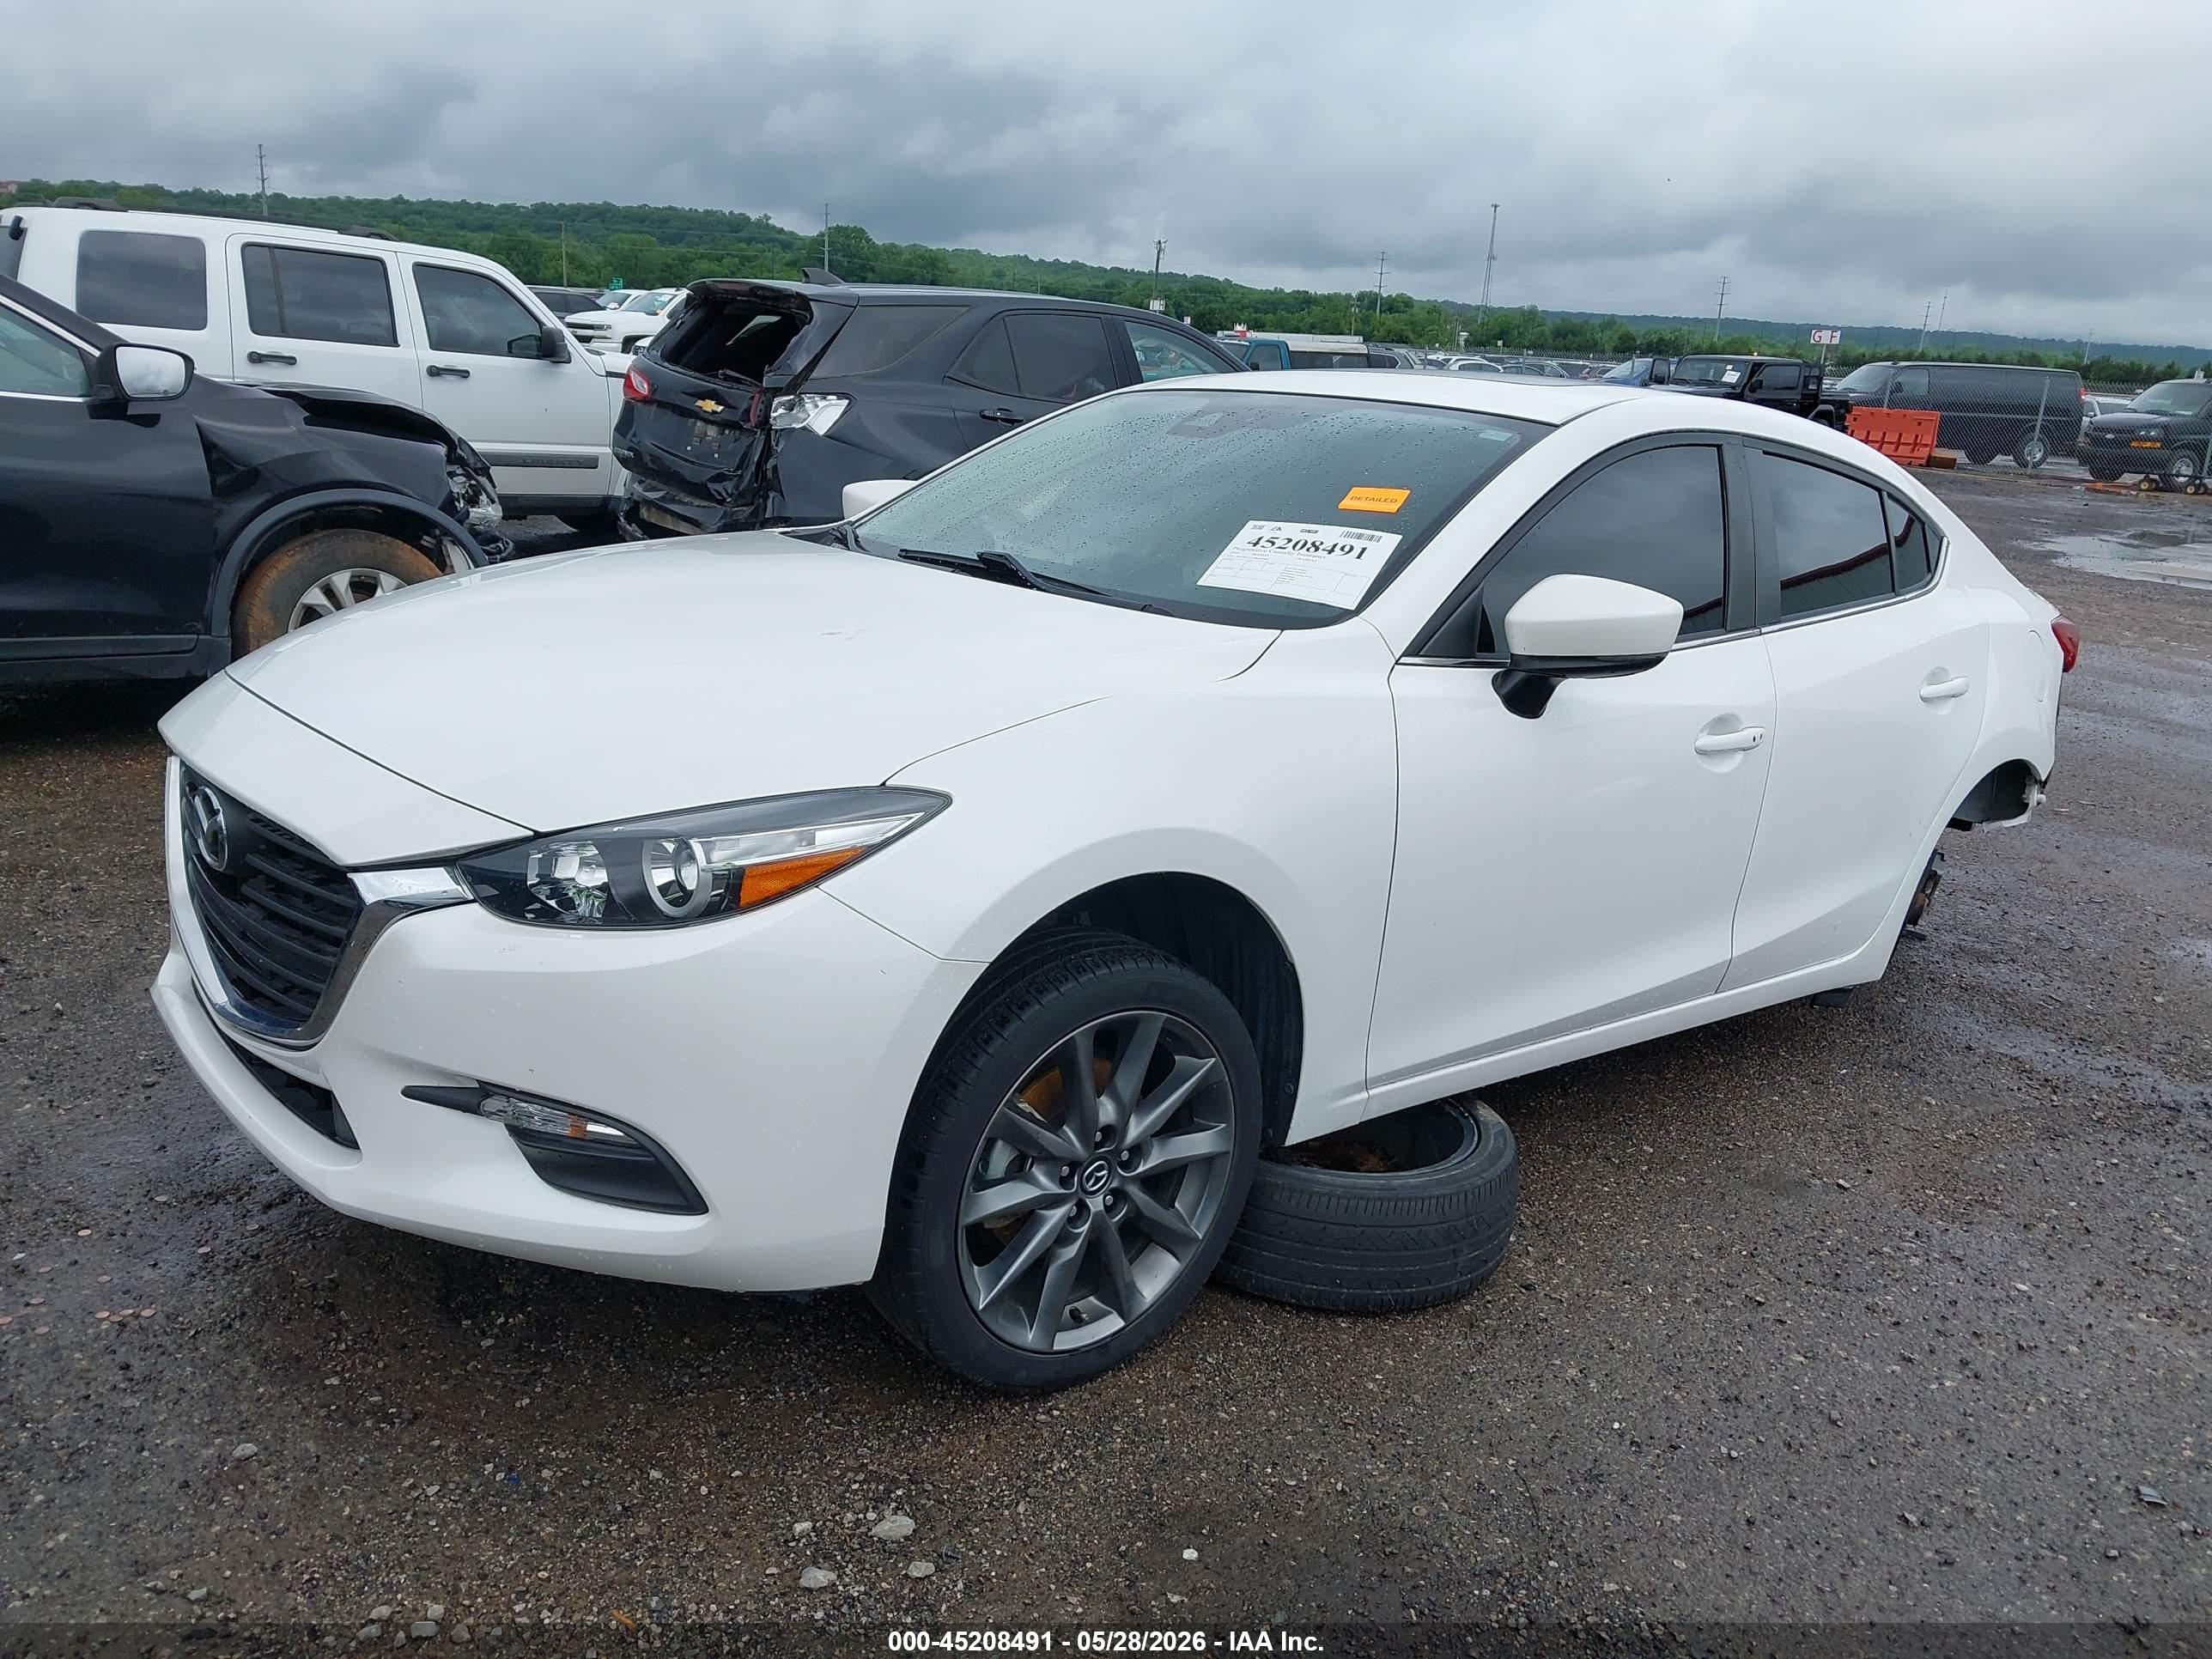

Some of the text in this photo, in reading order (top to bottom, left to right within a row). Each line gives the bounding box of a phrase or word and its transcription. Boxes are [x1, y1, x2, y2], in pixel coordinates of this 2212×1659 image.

[1813, 330, 1838, 343] G F
[1247, 535, 1369, 561] 45208491
